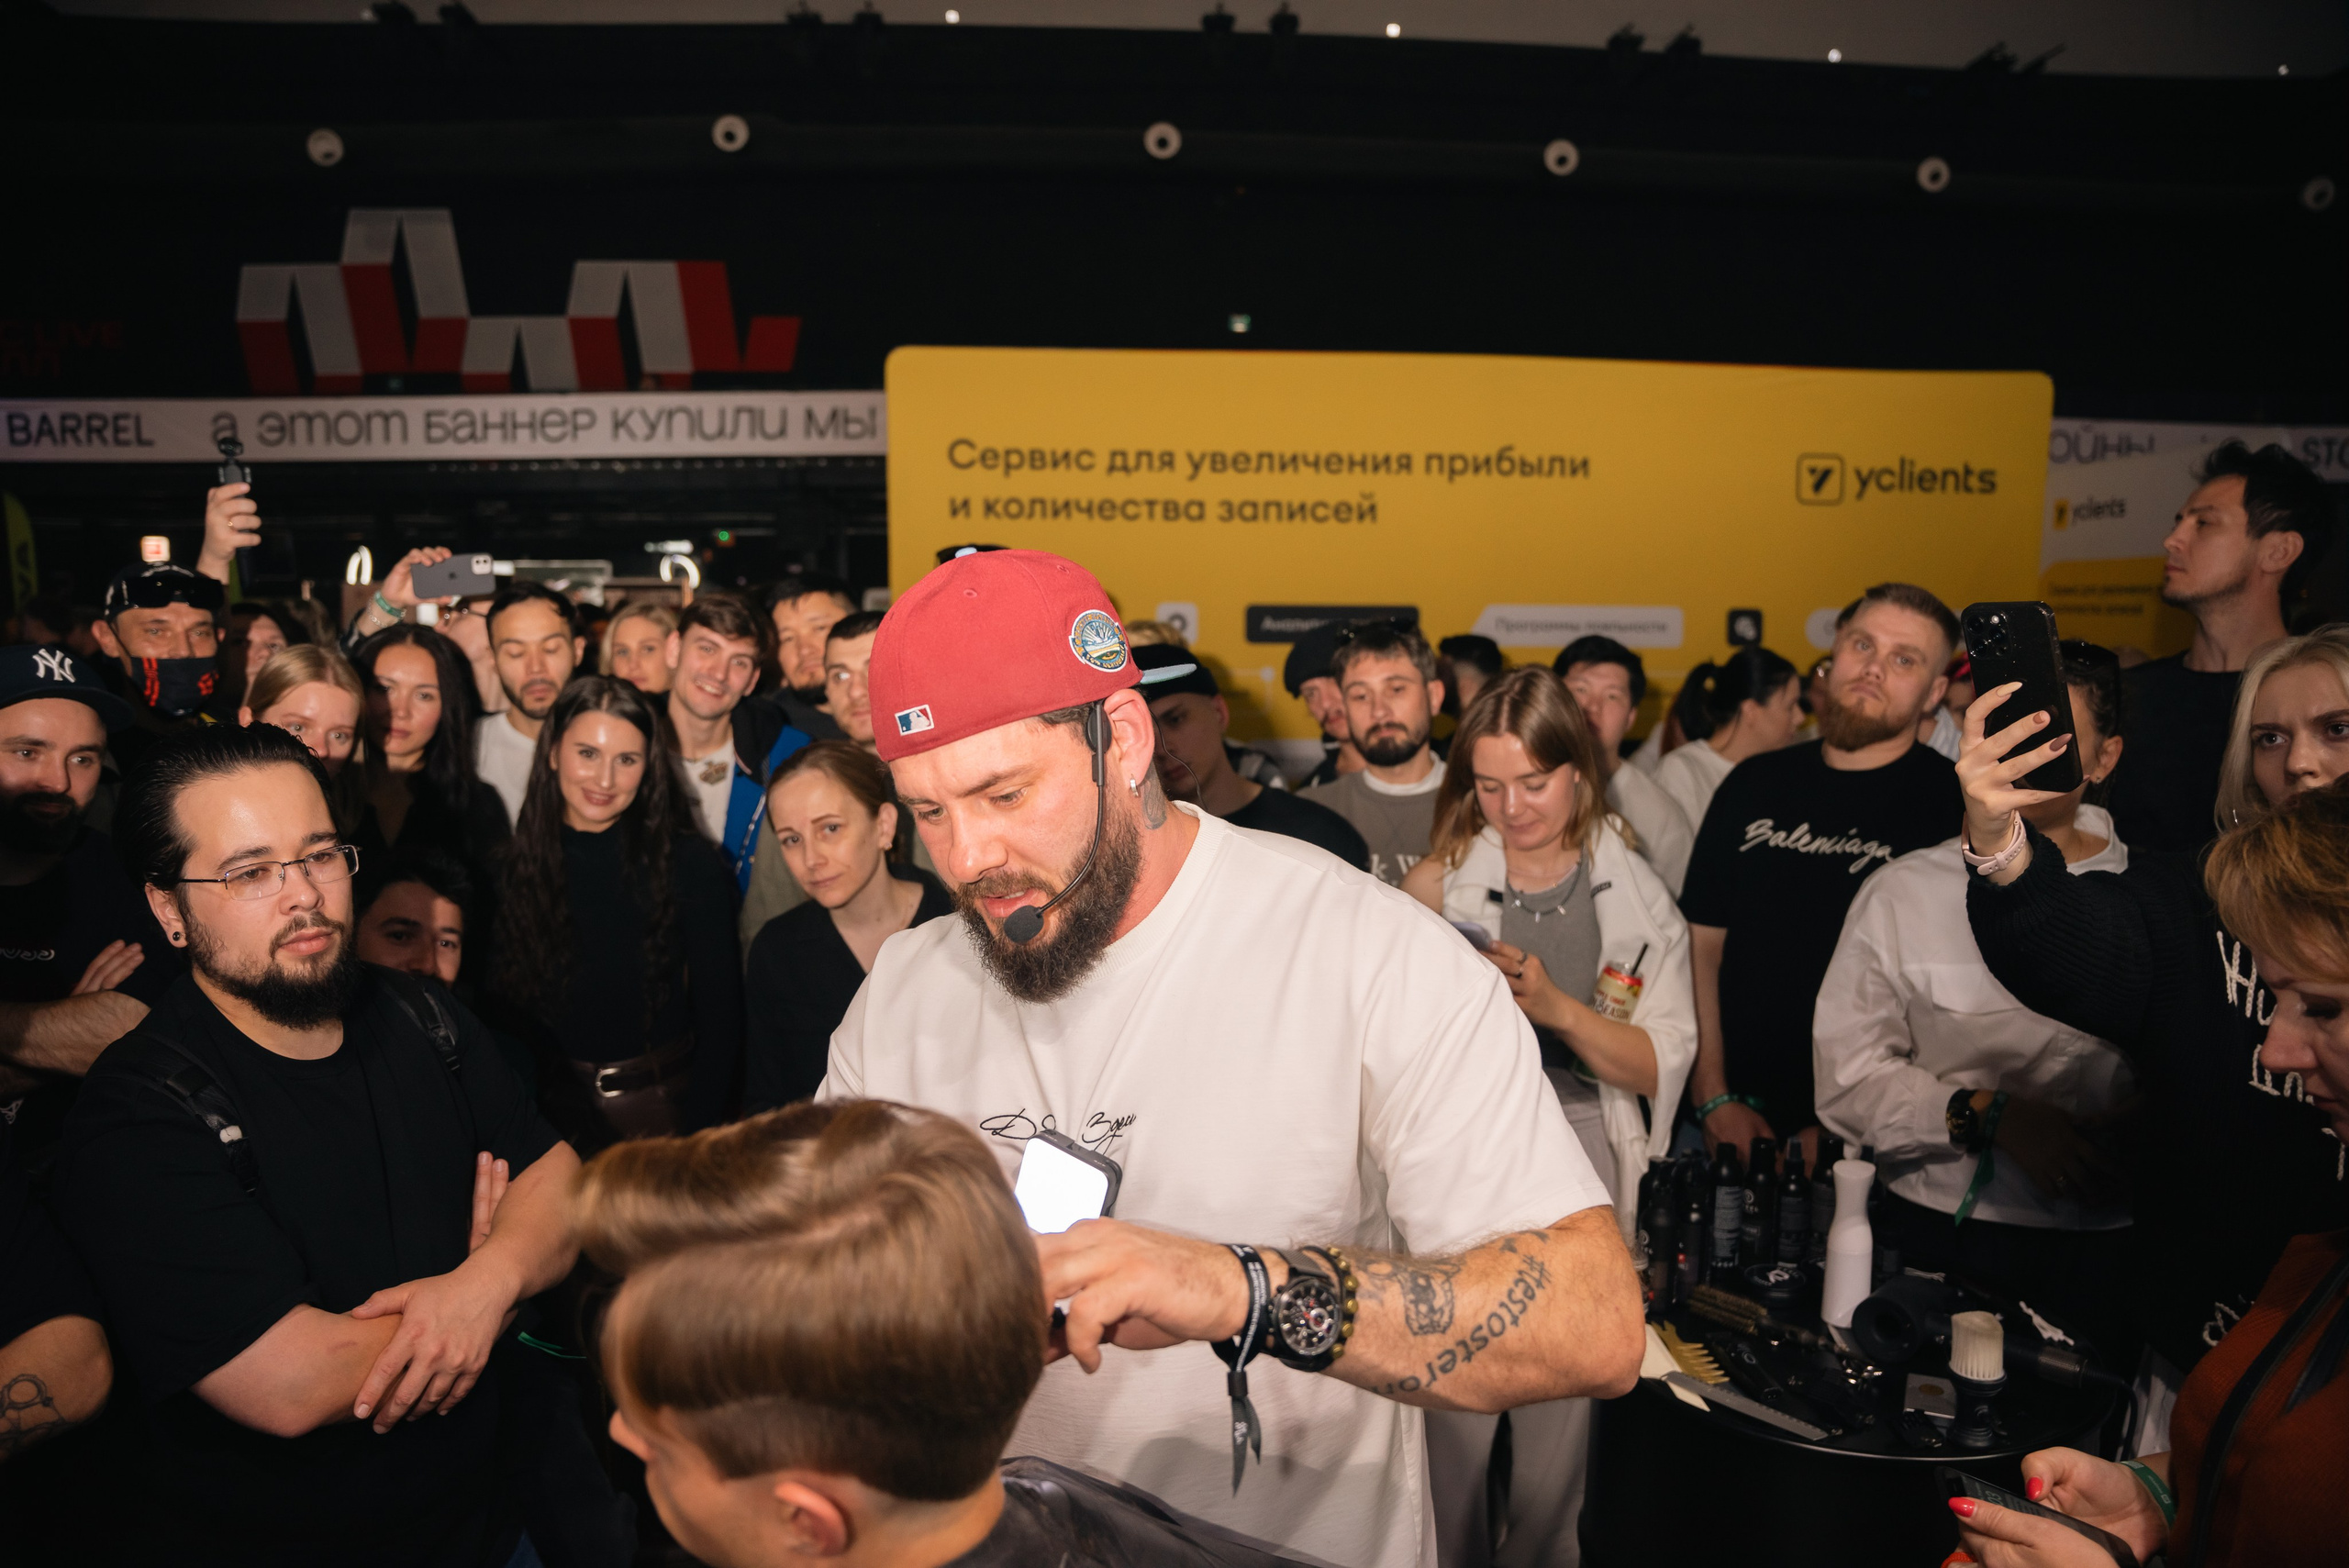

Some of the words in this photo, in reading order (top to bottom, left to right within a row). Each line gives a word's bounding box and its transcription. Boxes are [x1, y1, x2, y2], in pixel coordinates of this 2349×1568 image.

[7, 412, 154, 447] BARREL
[612, 405, 787, 442] купили
[804, 406, 876, 440] мы
[948, 438, 1097, 478] Сервис
[1107, 446, 1175, 475] для
[1185, 447, 1413, 480] увеличения
[1424, 445, 1591, 483] прибыли
[1854, 456, 1998, 500] yclients
[950, 496, 971, 519] и
[983, 495, 1207, 522] количества
[1218, 491, 1378, 525] записей
[32, 648, 76, 684] NY
